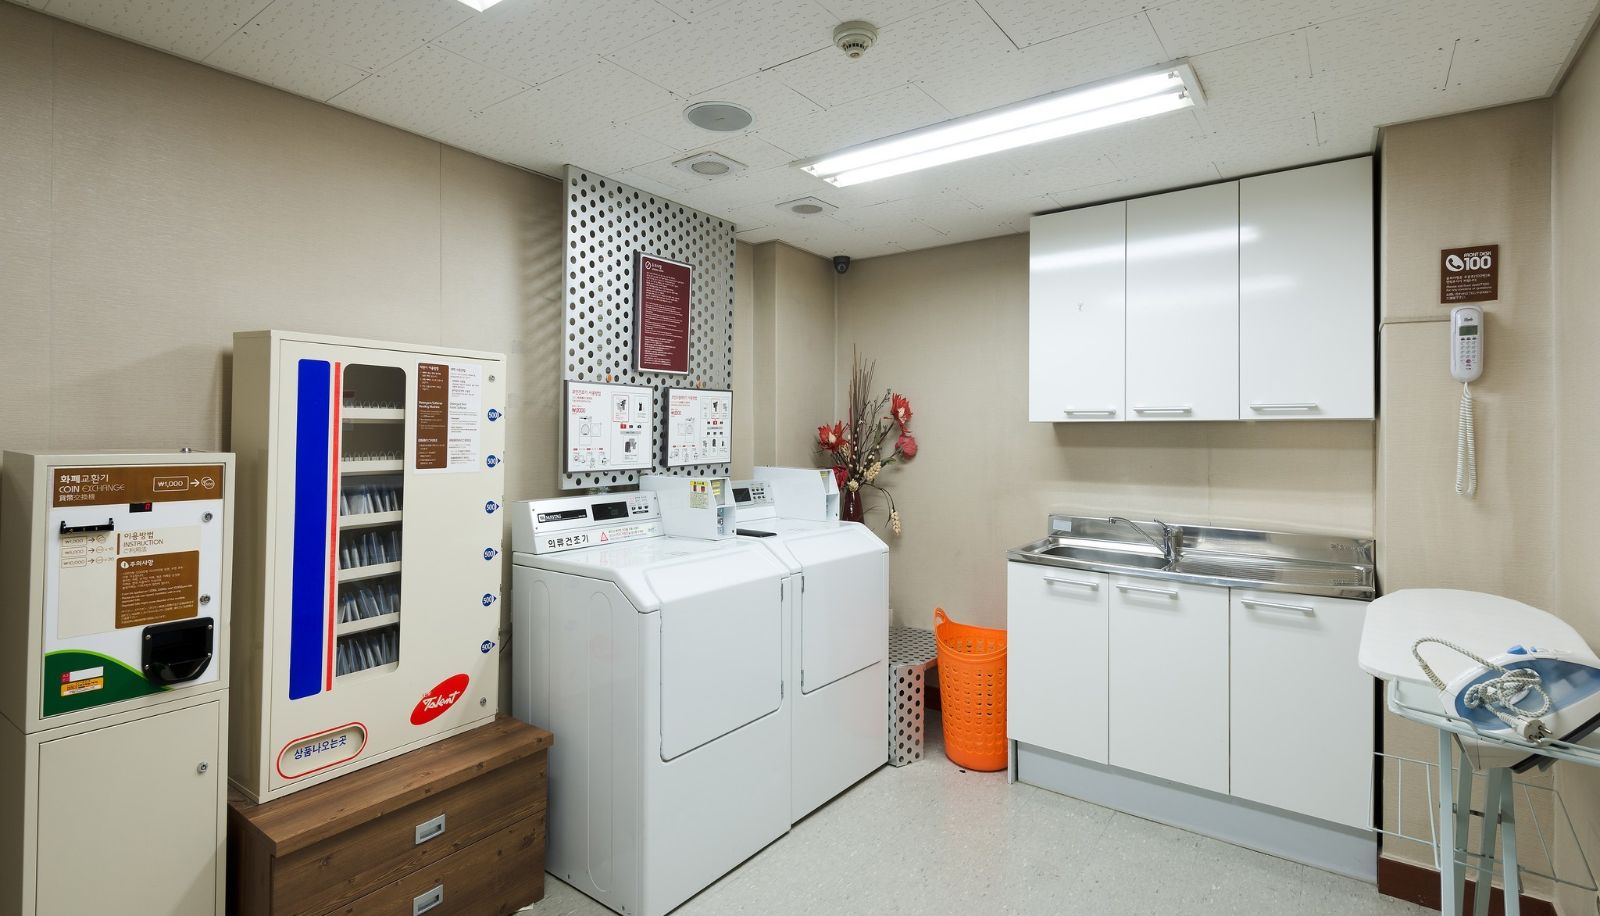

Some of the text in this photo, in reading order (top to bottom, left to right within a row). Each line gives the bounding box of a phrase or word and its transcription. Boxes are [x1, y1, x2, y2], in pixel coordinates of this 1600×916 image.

[1463, 256, 1492, 270] 100
[488, 411, 498, 419] 500
[487, 457, 497, 465] 500
[60, 474, 109, 484] 화폐교환기
[58, 483, 126, 494] COIN EXCHANGE
[486, 503, 496, 512] 500
[123, 531, 154, 540] 이용방법
[123, 539, 164, 548] INSTRUCTION
[548, 534, 589, 548] 의류건조기
[484, 550, 494, 558] 500
[130, 559, 154, 568] 주의사항
[483, 596, 493, 604] 500
[422, 690, 461, 712] Talent
[294, 735, 348, 760] 상품나오는곳
